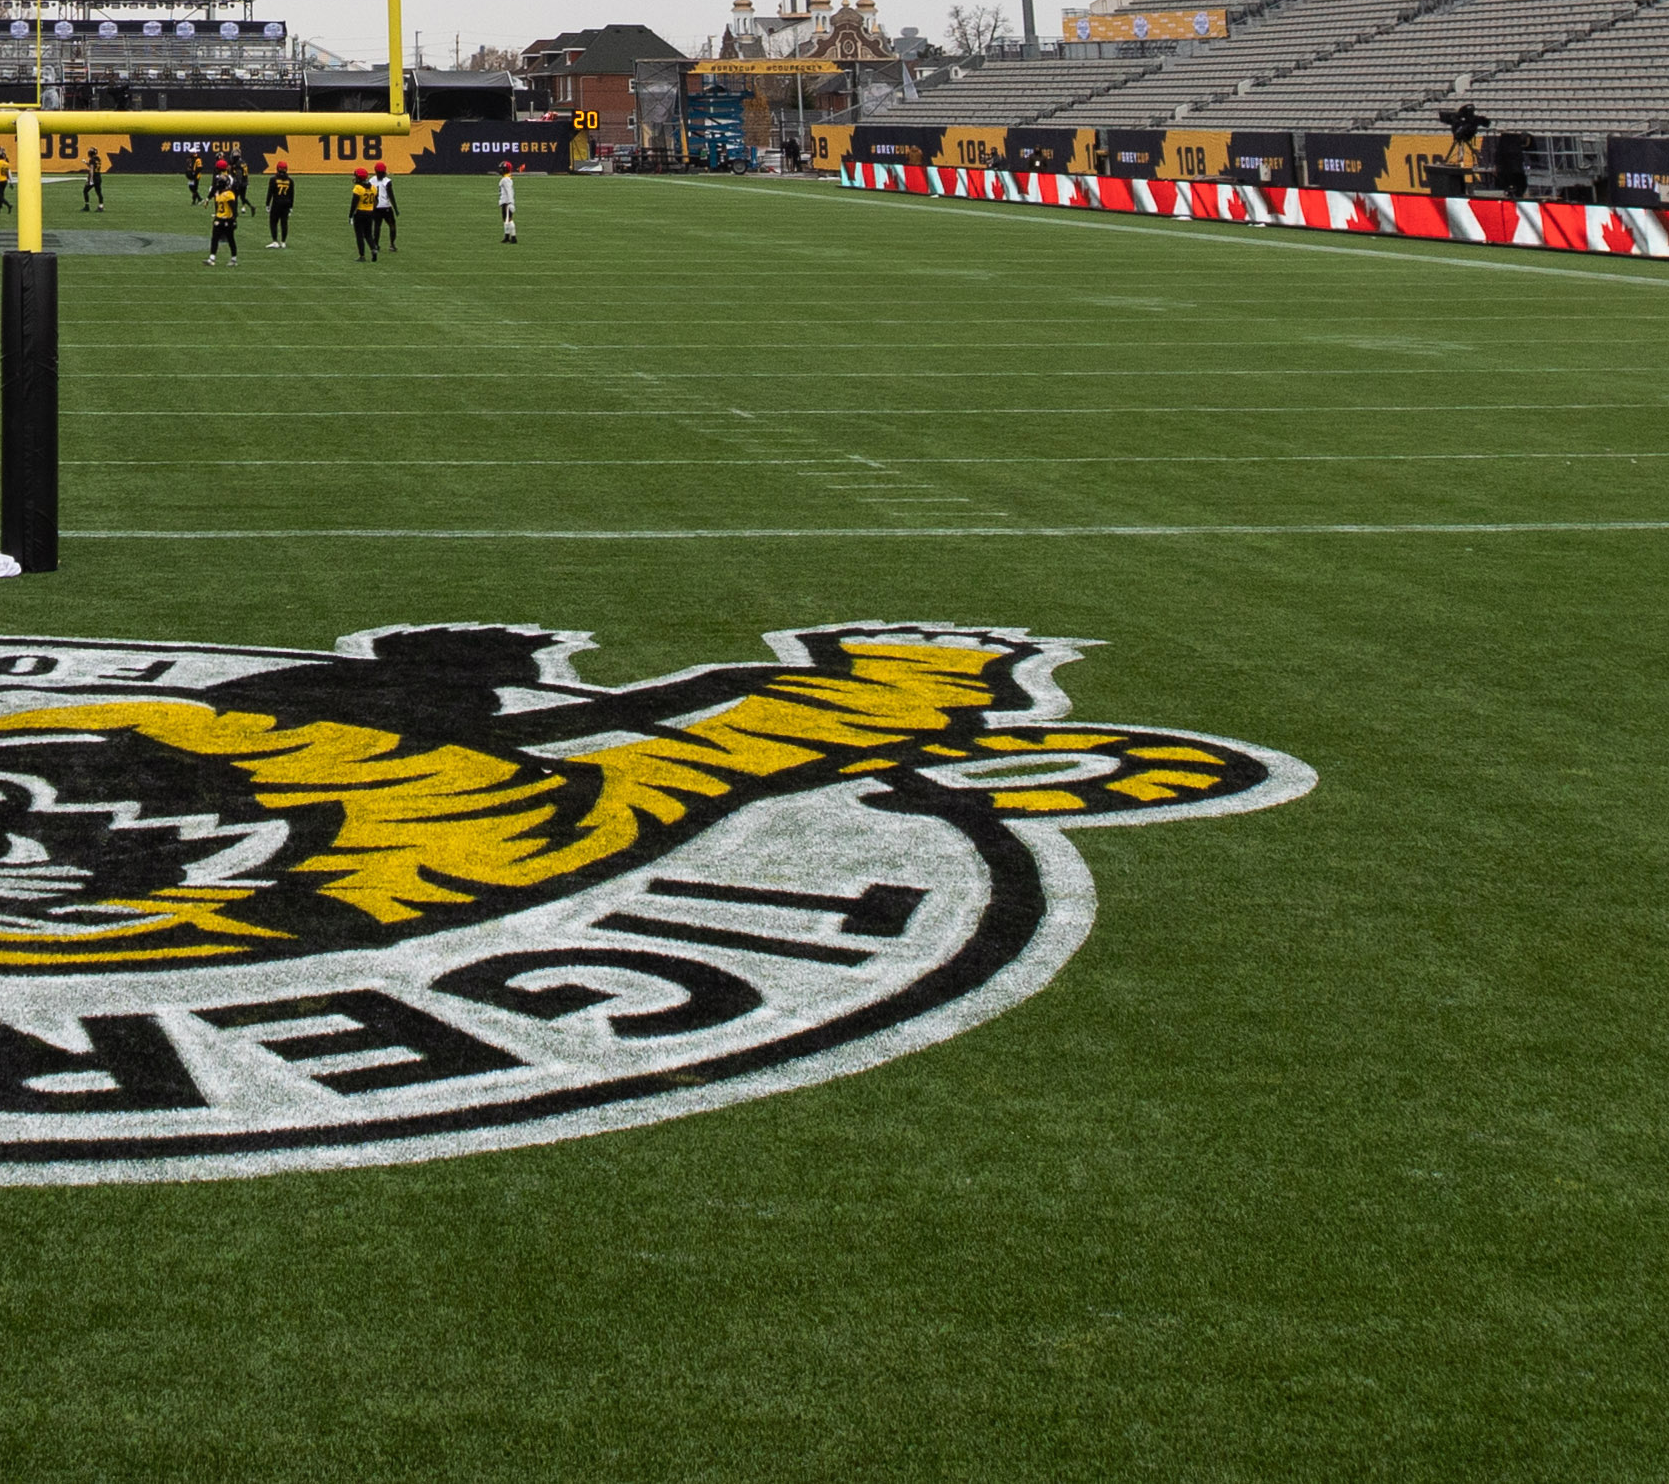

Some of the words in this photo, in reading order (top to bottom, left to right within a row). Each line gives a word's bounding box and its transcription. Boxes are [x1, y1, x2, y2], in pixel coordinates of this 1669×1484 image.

[574, 110, 599, 130] 20
[161, 141, 241, 153] #GREYCUP
[319, 134, 382, 161] 108
[461, 142, 558, 154] #COUPEGREY
[957, 139, 987, 165] 108
[1117, 151, 1150, 164] #GREYCUP
[1175, 146, 1206, 176] 108
[1317, 158, 1363, 174] #GREYCUP
[277, 184, 289, 196] 77
[362, 192, 374, 205] 20
